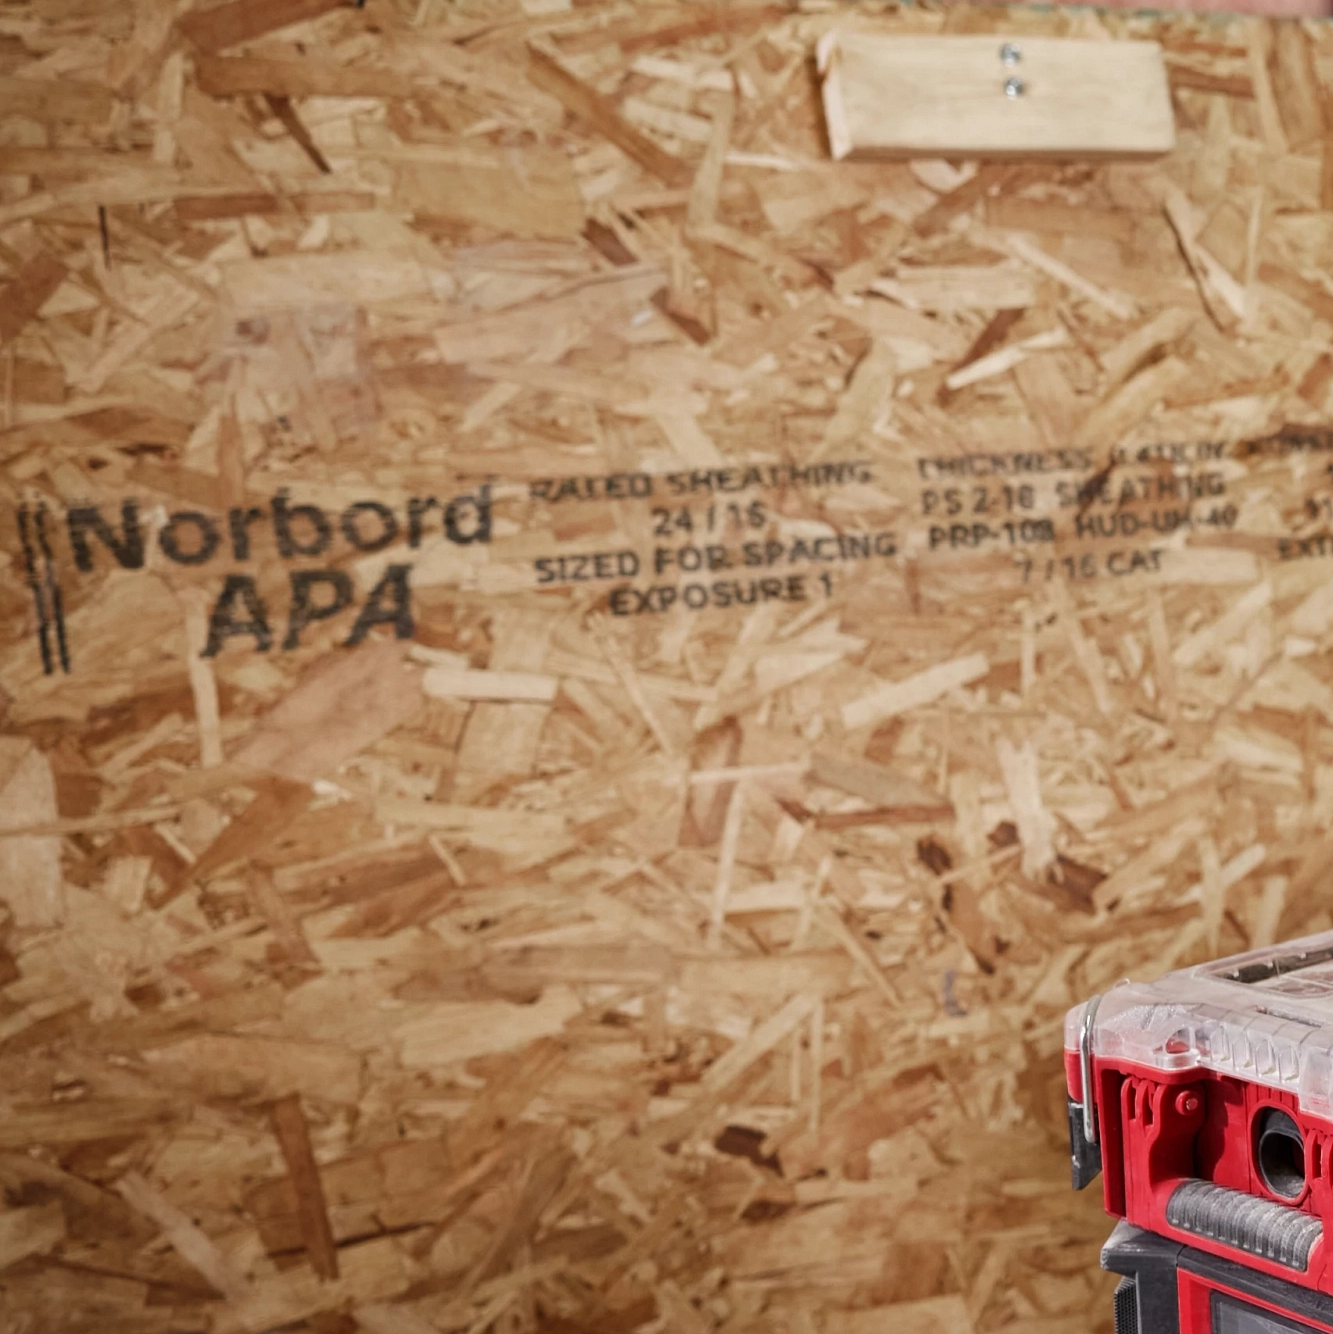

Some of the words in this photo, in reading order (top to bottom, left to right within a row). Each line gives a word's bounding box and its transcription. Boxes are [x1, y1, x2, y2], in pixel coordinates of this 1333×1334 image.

[529, 472, 652, 504] RATED
[668, 458, 873, 497] SHEATHING
[66, 475, 495, 571] Norbord
[534, 550, 640, 584] SIZED
[653, 544, 733, 576] FOR
[742, 530, 899, 569] SPACING
[1106, 546, 1169, 577] CAT
[198, 562, 416, 658] APA
[608, 573, 809, 617] EXPOSURE
[818, 573, 834, 599] 1
